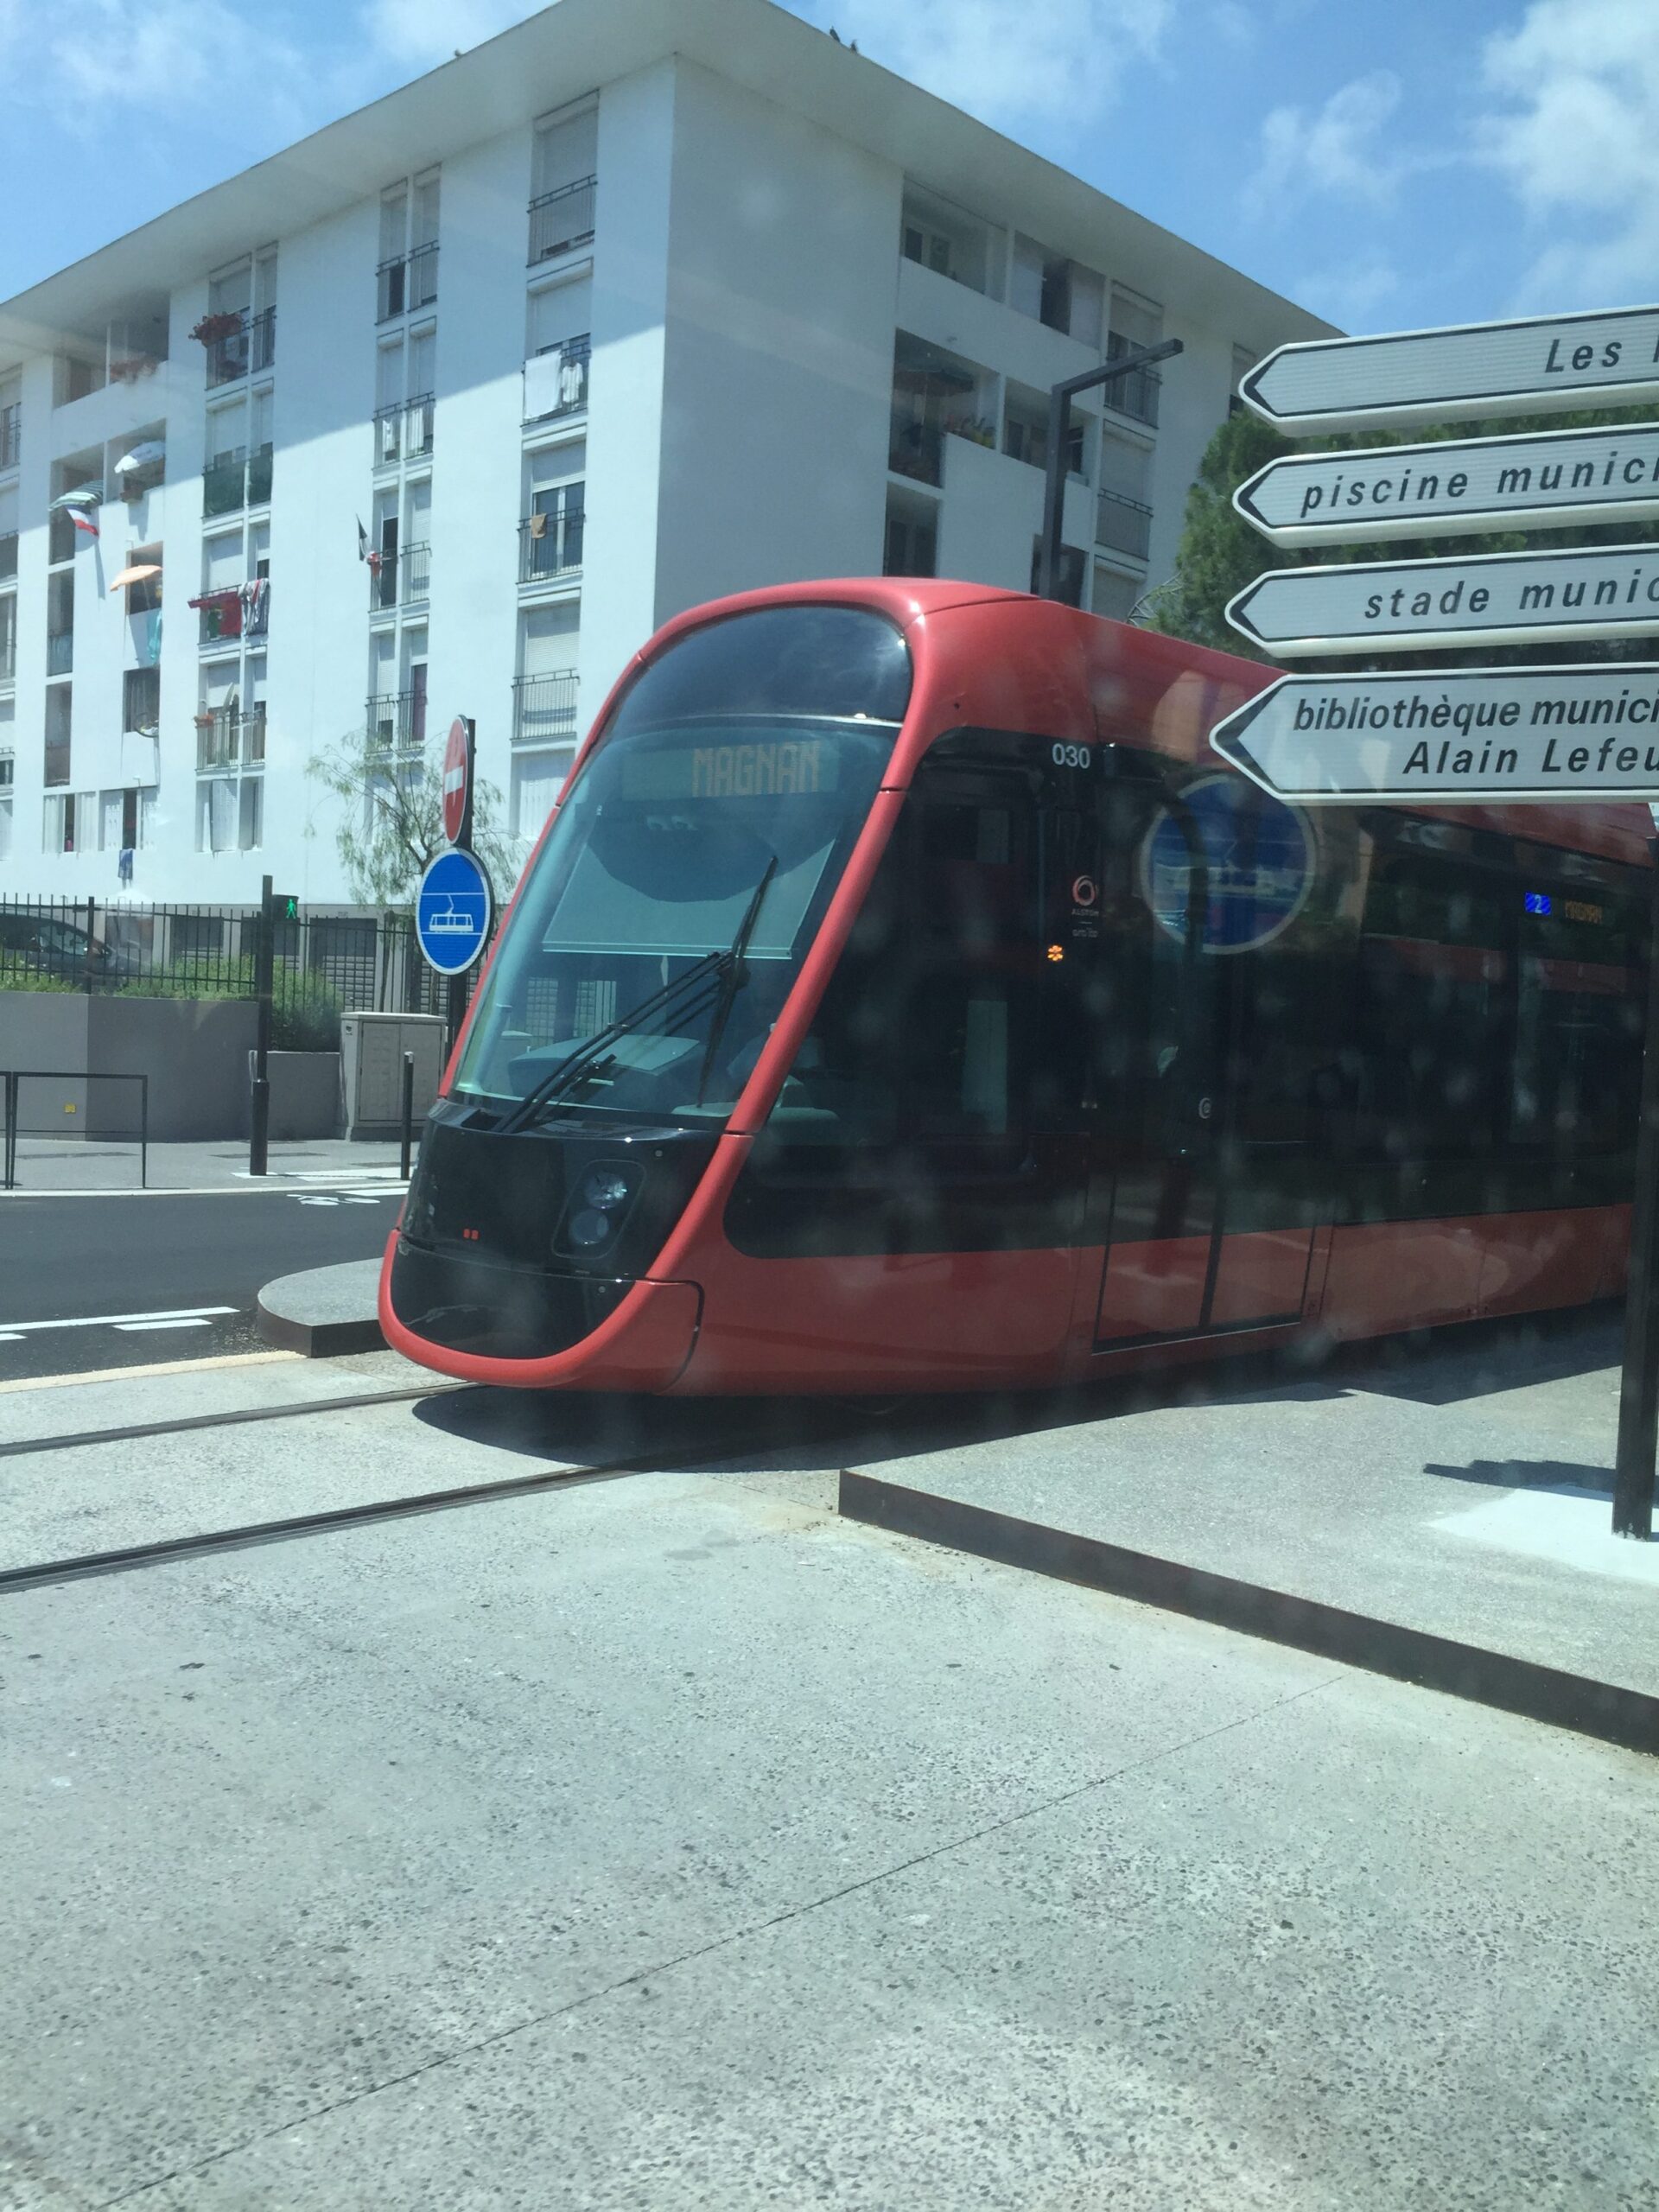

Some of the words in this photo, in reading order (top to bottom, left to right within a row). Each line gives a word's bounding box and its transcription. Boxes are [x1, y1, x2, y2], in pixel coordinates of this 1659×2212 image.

[1545, 339, 1622, 373] Les
[1300, 468, 1468, 518] piscine
[1364, 581, 1490, 619] stade
[1294, 695, 1521, 736] bibliothèque
[692, 741, 821, 798] MAGNAN
[1052, 743, 1090, 769] 030
[1402, 741, 1518, 774] Alain
[1534, 893, 1542, 914] 2
